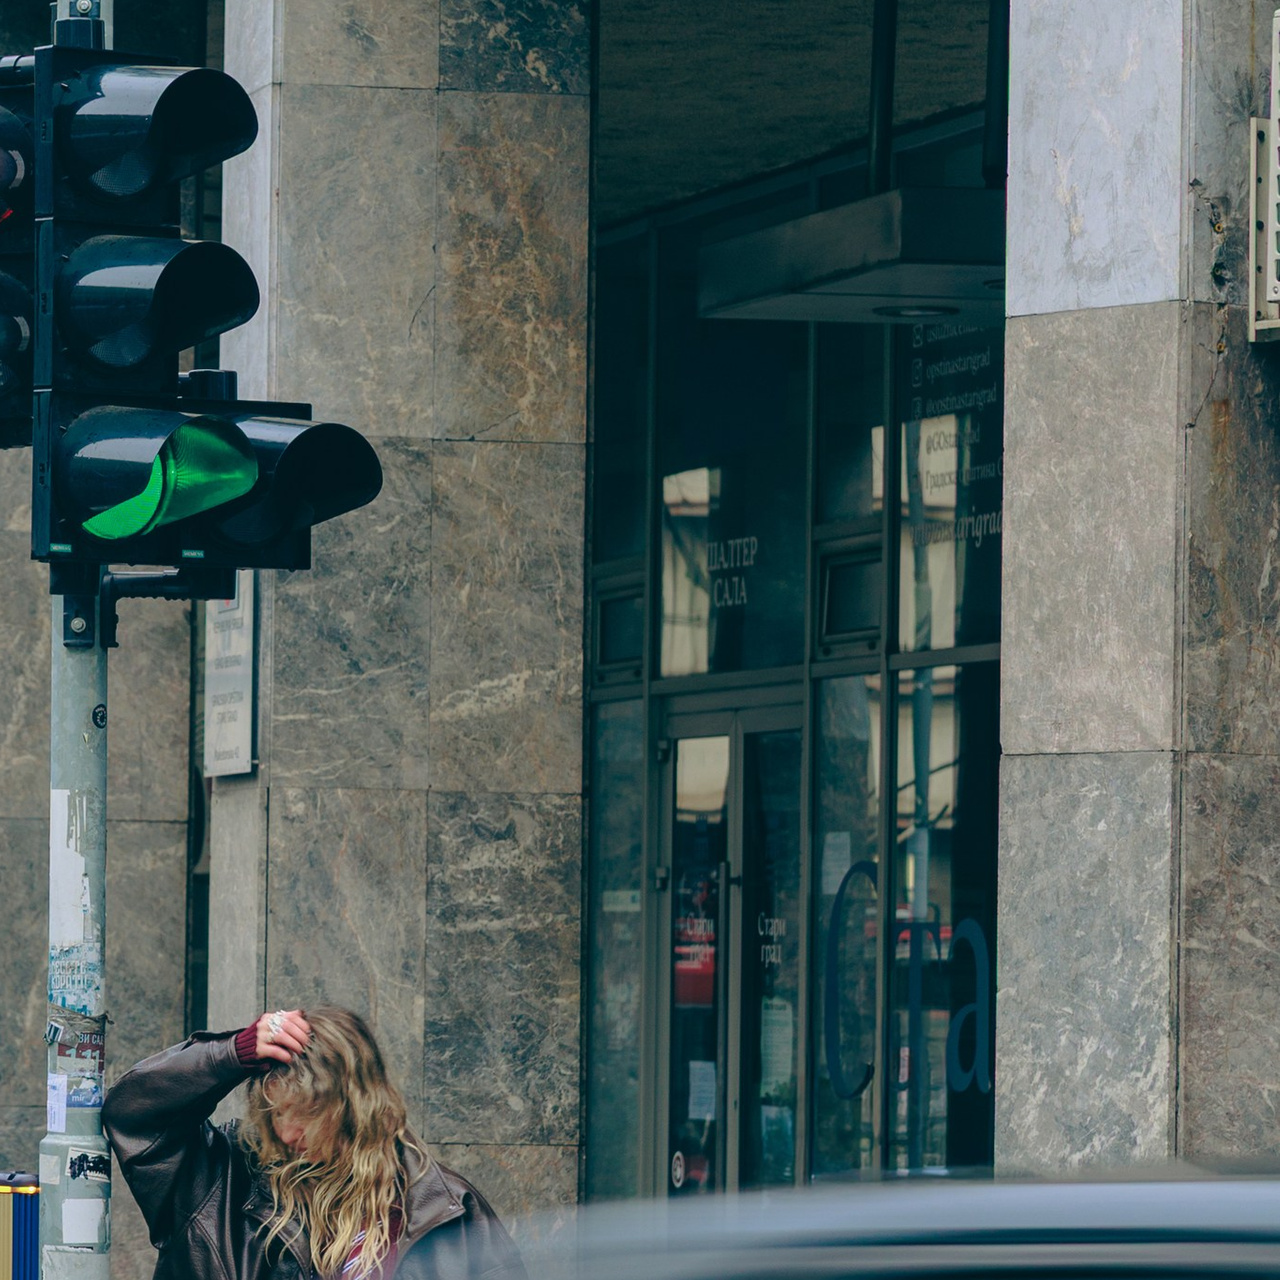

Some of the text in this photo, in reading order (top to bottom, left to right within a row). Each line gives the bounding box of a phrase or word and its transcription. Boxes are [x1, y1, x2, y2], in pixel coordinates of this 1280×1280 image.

[706, 536, 758, 571] ШАЛТЕР
[713, 576, 748, 608] САЛА
[757, 911, 787, 942] Стари
[761, 944, 782, 968] град
